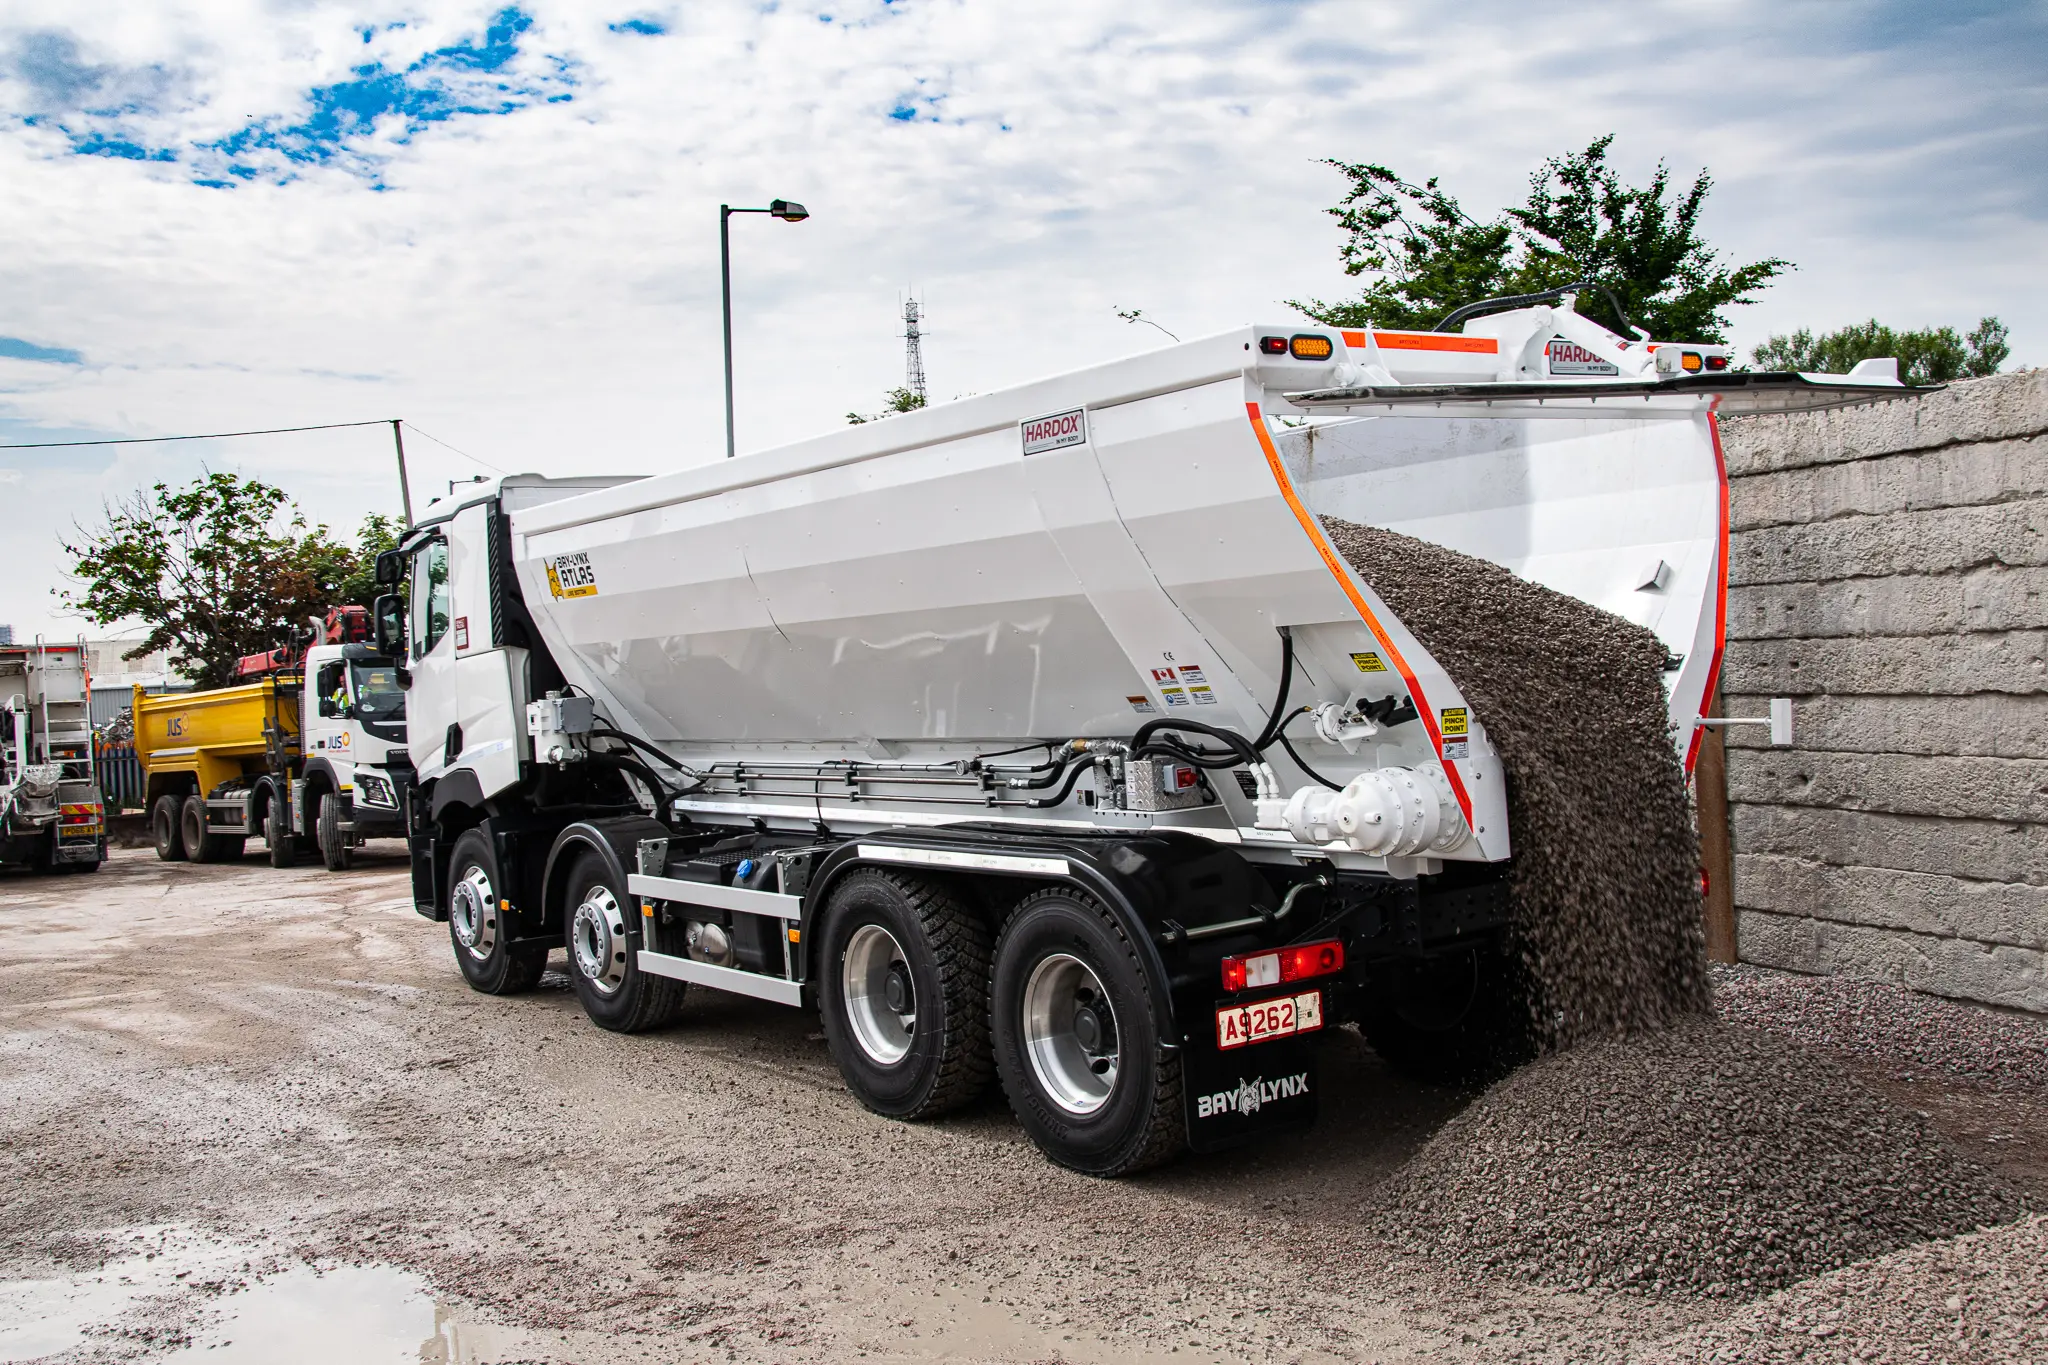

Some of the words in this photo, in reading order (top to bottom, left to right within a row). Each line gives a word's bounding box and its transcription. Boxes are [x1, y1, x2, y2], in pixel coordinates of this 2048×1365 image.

[1025, 414, 1079, 443] HARDOX
[561, 565, 595, 588] ATLAS
[1444, 717, 1465, 725] PINCH
[1226, 1003, 1294, 1041] A9262
[1197, 1088, 1239, 1118] BAY
[1260, 1072, 1309, 1104] LYNX
